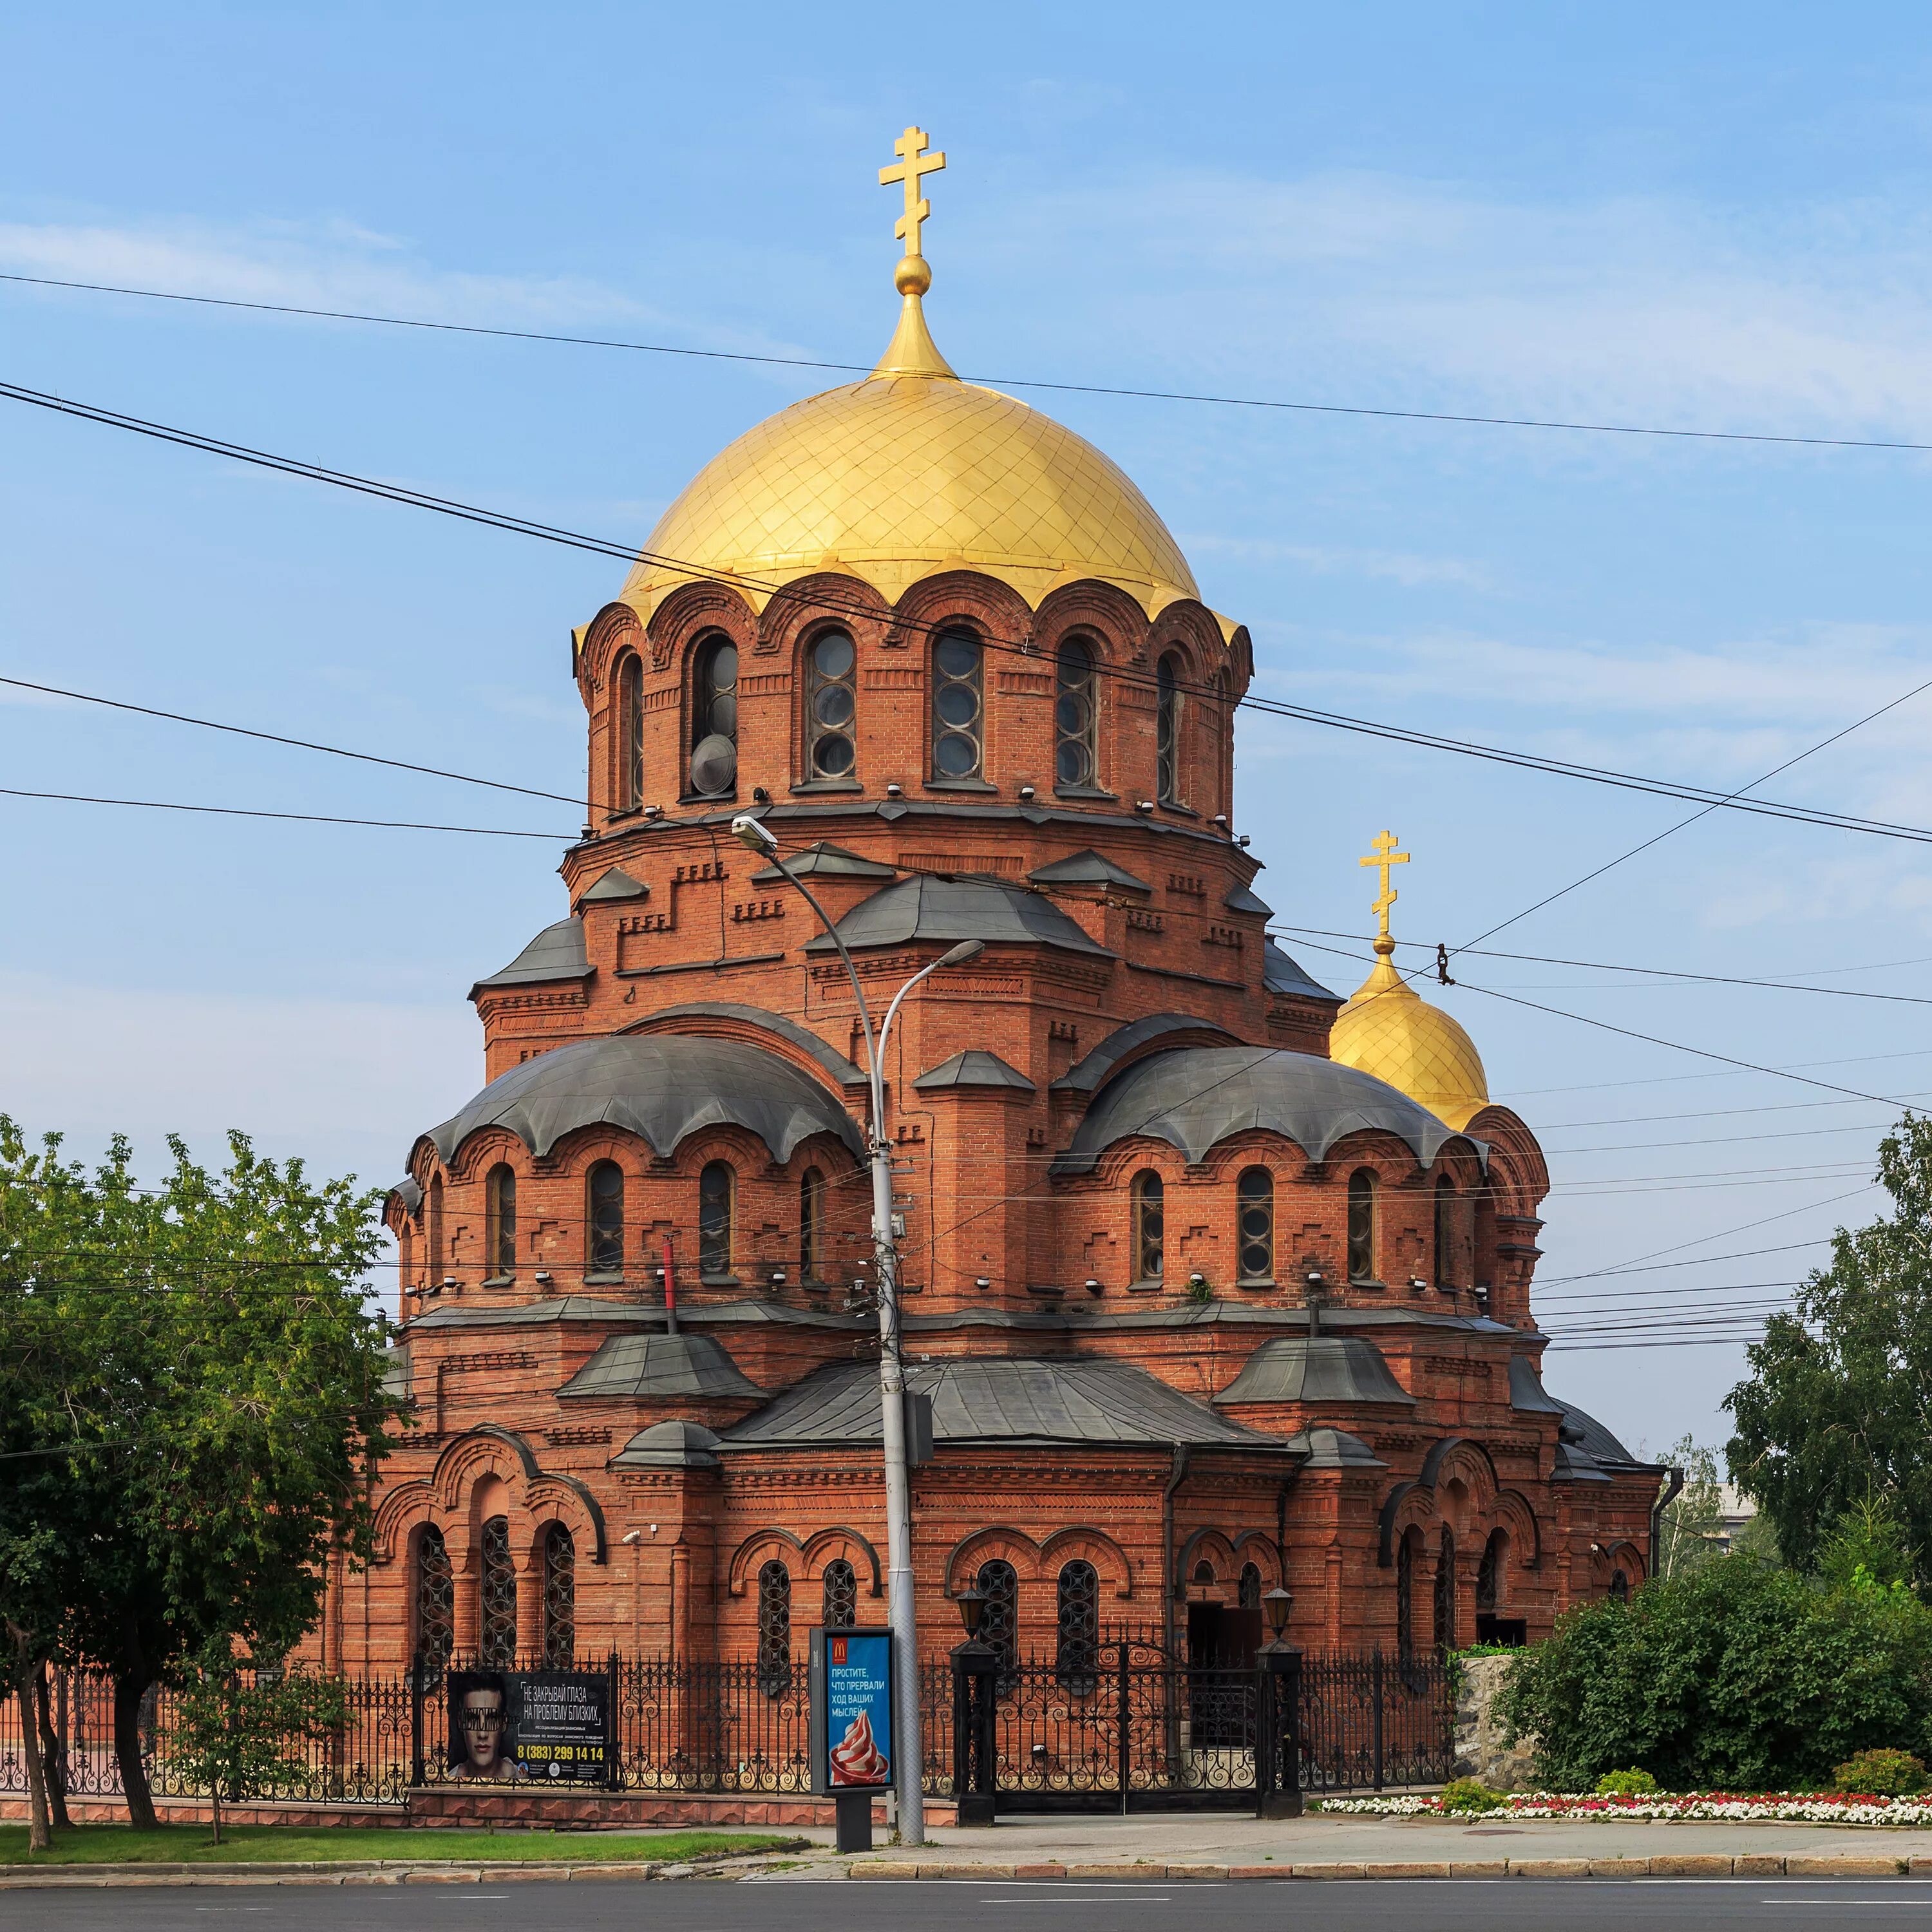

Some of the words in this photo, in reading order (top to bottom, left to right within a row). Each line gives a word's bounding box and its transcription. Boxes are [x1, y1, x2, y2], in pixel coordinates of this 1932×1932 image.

[831, 1668, 869, 1678] ПРОСТИТЕ,
[831, 1681, 845, 1690] ЧТО
[846, 1681, 885, 1690] ПРЕРВАЛИ
[524, 1686, 532, 1701] НЕ
[533, 1683, 566, 1702] ЗАКРЫВАЙ
[567, 1687, 587, 1702] ГЛАЗА
[831, 1694, 847, 1705] ХОД
[848, 1694, 874, 1703] ВАШИХ
[524, 1704, 533, 1719] НА
[533, 1704, 567, 1720] ПРОБЛЕМУ
[568, 1705, 598, 1721] БЛИЗКИХ
[517, 1745, 524, 1759] 8
[526, 1745, 552, 1760] (383)
[554, 1746, 573, 1760] 299
[576, 1747, 588, 1761] 14
[590, 1747, 603, 1761] 14
